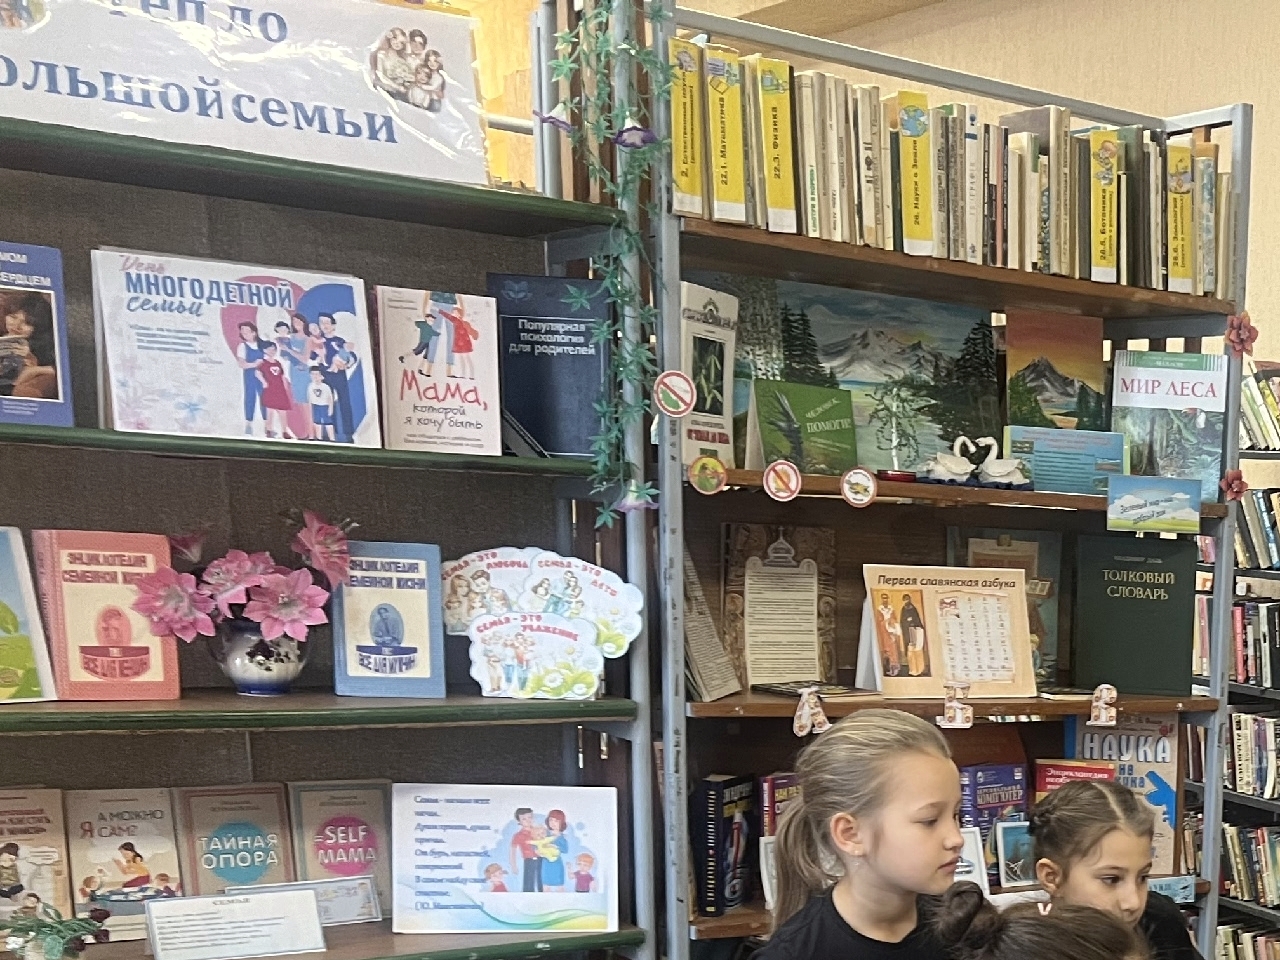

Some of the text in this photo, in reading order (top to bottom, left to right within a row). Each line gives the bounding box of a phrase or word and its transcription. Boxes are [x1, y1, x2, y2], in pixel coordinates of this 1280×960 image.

[718, 97, 727, 159] Математика
[771, 106, 779, 149] Физика
[1099, 188, 1107, 235] Ботаника
[125, 271, 294, 310] МНОГОДЕТНОЙ
[517, 318, 586, 333] Популярная
[520, 332, 585, 344] психология
[508, 342, 597, 356] для родителей
[401, 368, 489, 411] Мама,
[1120, 377, 1217, 398] МИР ЛЕСА
[412, 403, 466, 420] которой
[417, 418, 445, 433] хочу
[448, 417, 484, 430] быть
[877, 574, 1017, 590] Первая славянская азбука
[1102, 569, 1176, 586] ТОЛКОВЫЙ
[1106, 585, 1169, 600] СЛОВАРЬ
[1082, 732, 1171, 763] НАУКА
[977, 790, 1023, 805] КОМПЬЮТЕР
[80, 821, 95, 838] Я
[198, 832, 279, 850] ТАЙНАЯ
[201, 850, 279, 871] ОПОРА
[318, 847, 377, 864] MAMA
